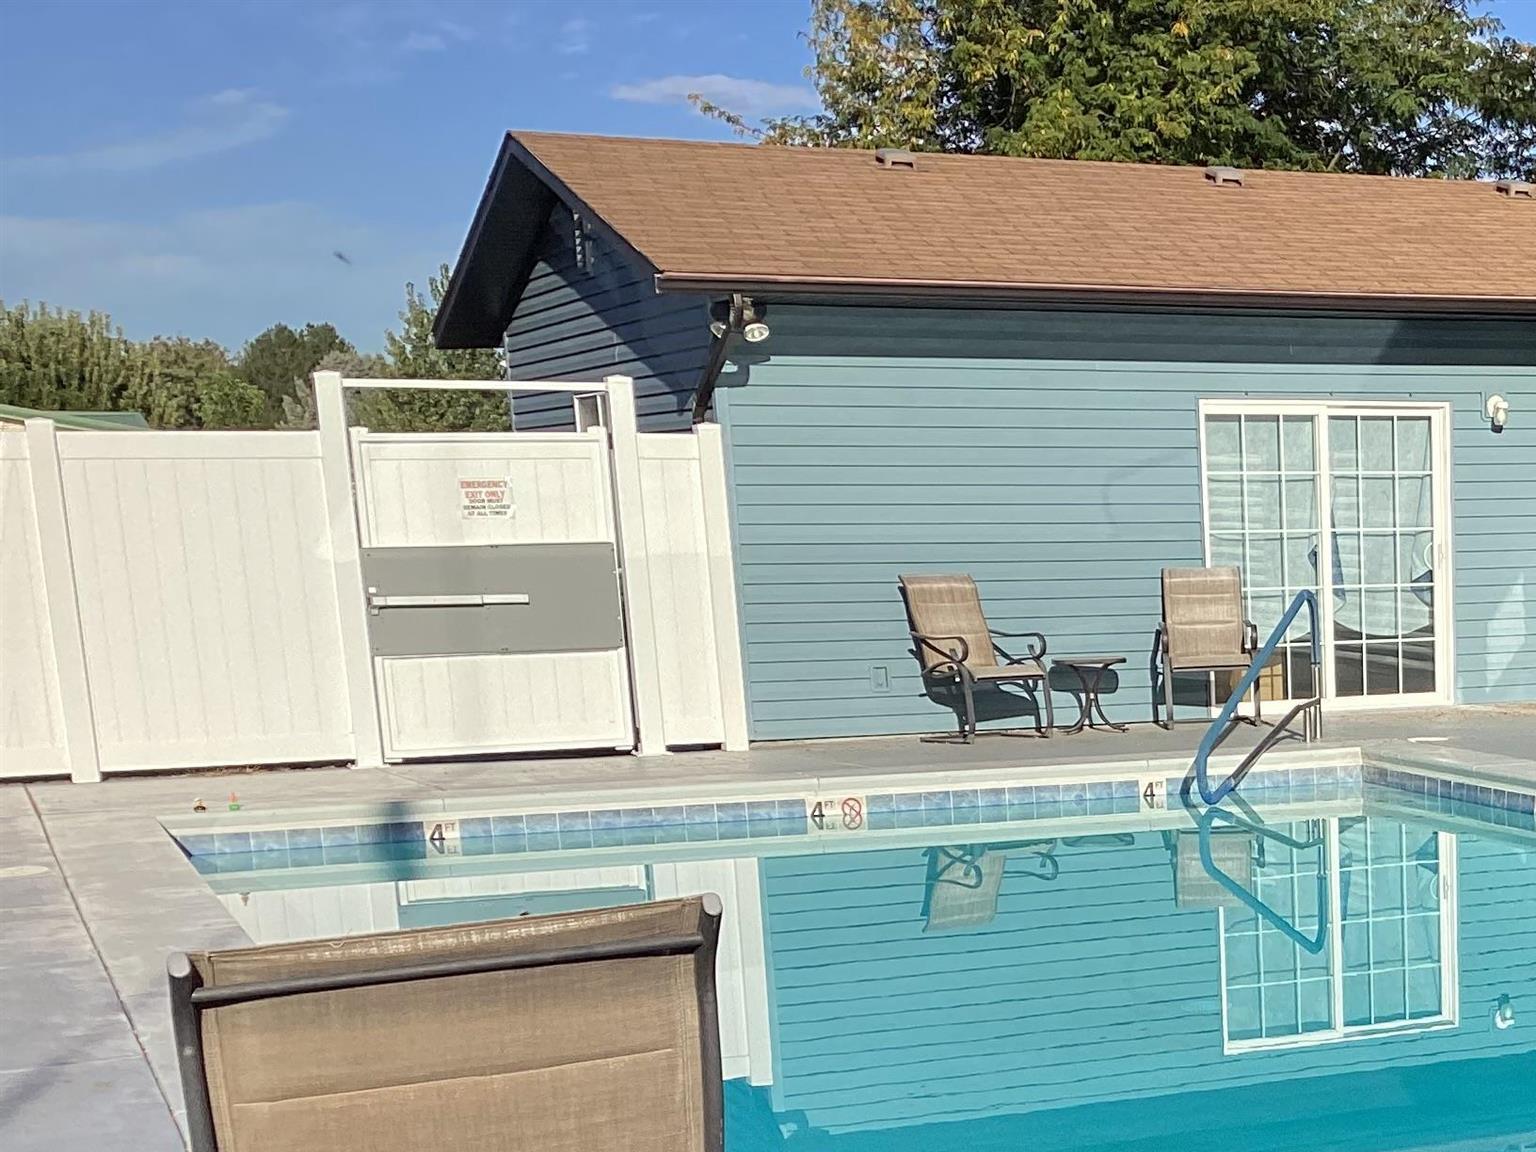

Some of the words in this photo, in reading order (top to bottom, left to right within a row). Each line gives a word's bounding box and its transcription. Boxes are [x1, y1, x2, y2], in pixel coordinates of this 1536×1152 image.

[460, 480, 507, 489] EMERGENCY
[465, 490, 482, 498] EXIT
[484, 490, 505, 499] ONLY
[1143, 782, 1155, 797] 4
[811, 802, 825, 817] 4
[430, 824, 446, 840] 4
[444, 822, 456, 832] FT
